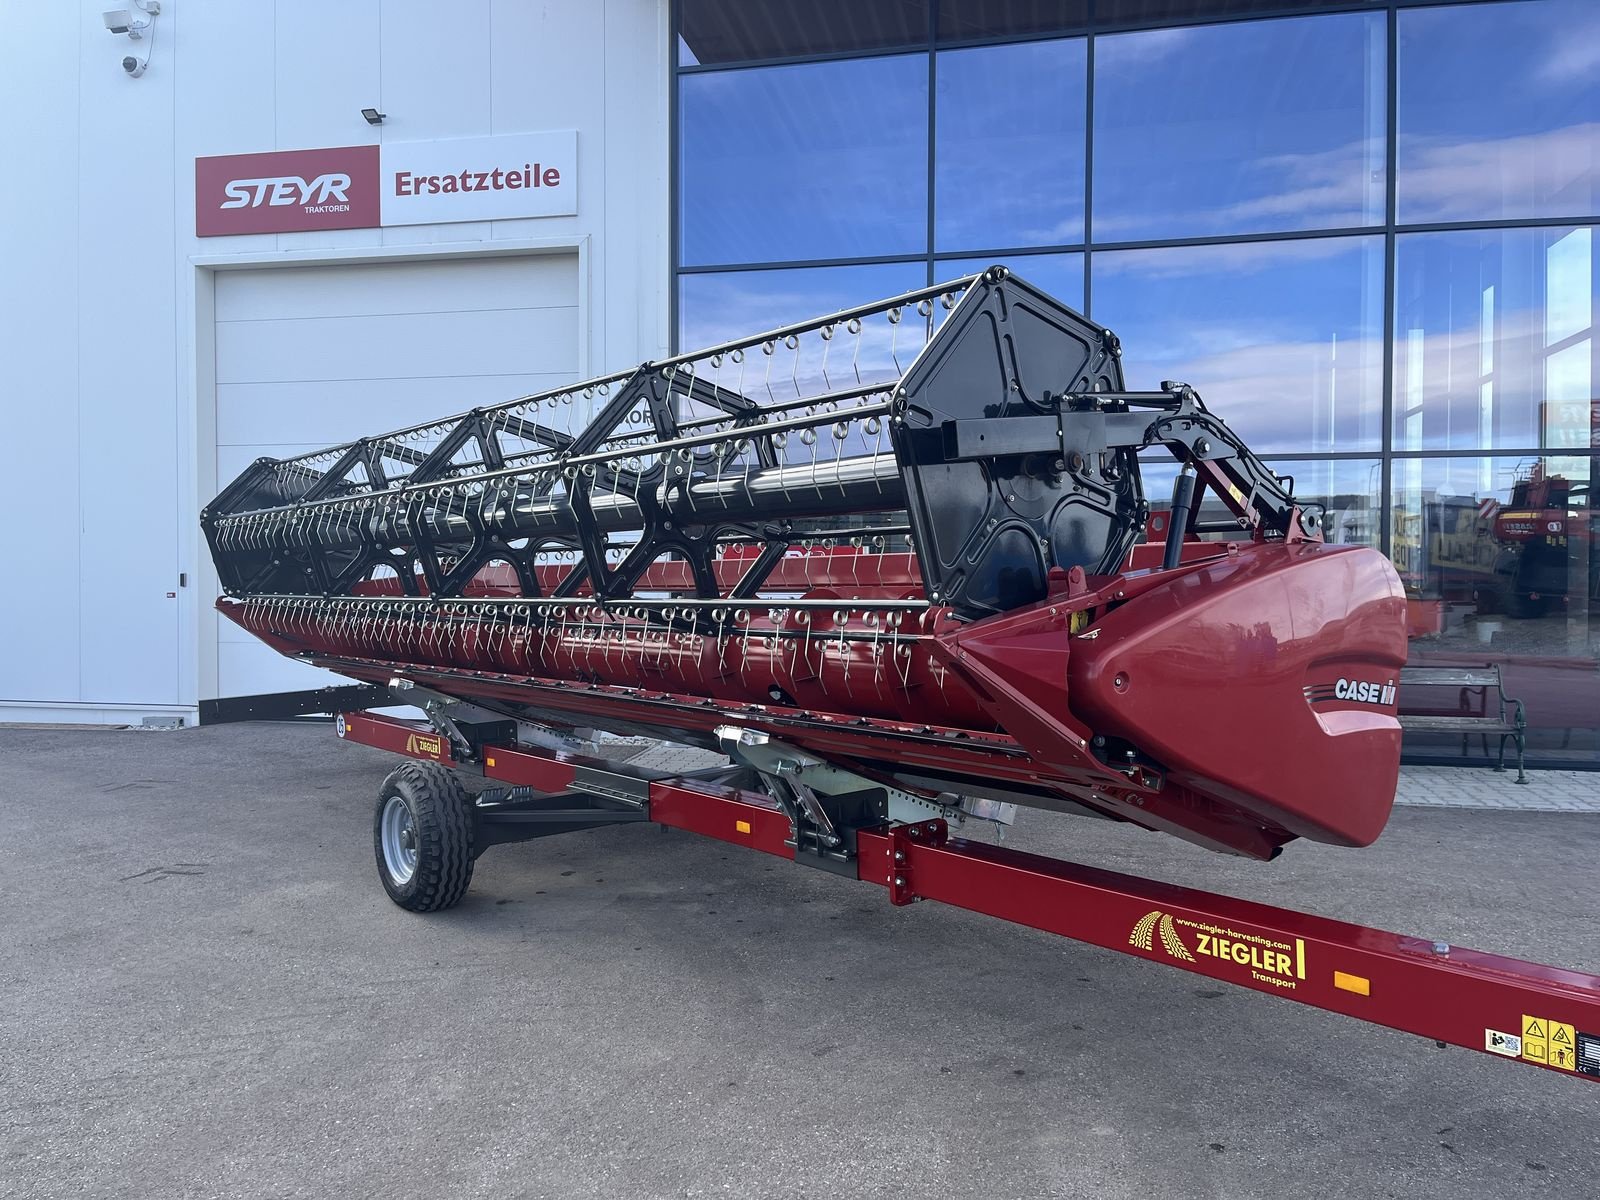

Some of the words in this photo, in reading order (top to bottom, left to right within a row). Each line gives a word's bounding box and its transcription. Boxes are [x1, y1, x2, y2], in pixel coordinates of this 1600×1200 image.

[220, 173, 351, 209] STEYR
[395, 163, 560, 197] Ersatzteile
[304, 205, 350, 214] TRAKTOREN
[1335, 679, 1380, 702] CASE
[419, 740, 438, 754] ZIEGLER
[1176, 918, 1291, 951] www.ziegler-harvesting.com
[1196, 933, 1293, 976] ZIEGLER
[1252, 971, 1296, 989] Transport
